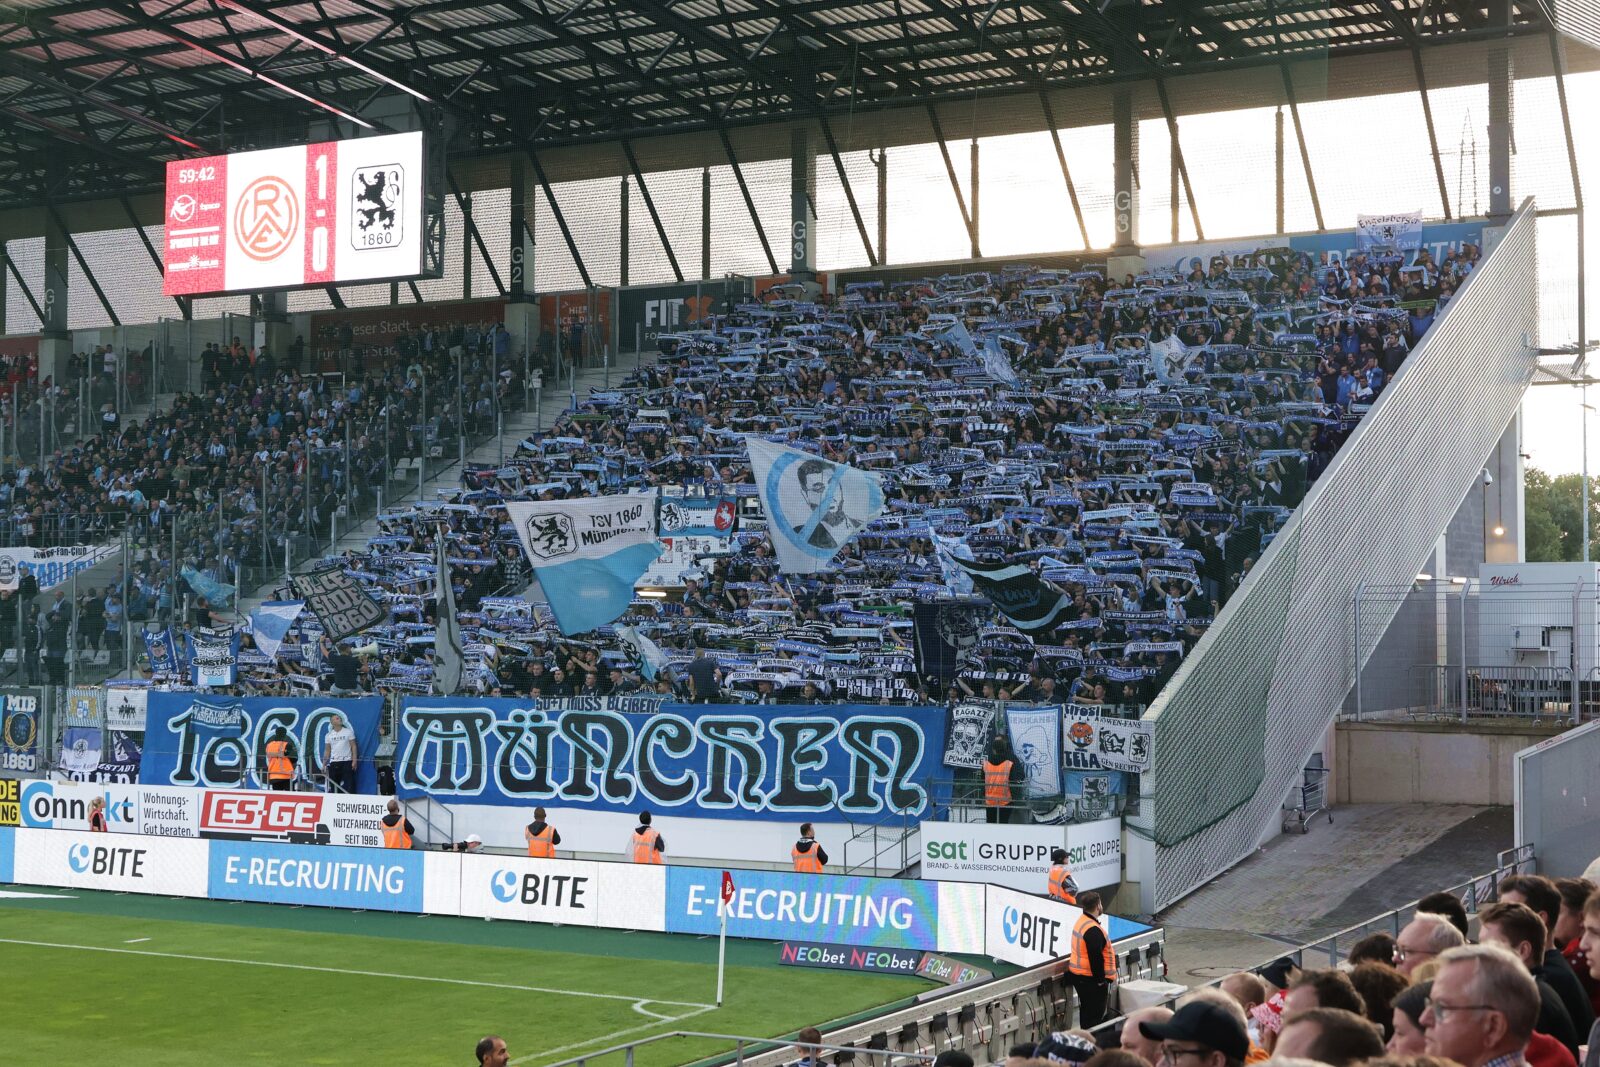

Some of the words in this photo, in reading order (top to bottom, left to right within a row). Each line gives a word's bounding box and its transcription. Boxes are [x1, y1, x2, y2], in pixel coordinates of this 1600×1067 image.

[179, 166, 214, 183] 59:42
[362, 232, 392, 246] 1860
[589, 514, 612, 528] TSV
[616, 504, 642, 526] 1860
[1489, 572, 1519, 586] Ulrich
[323, 599, 380, 638] 1860
[6, 694, 37, 712] MIB
[2, 752, 36, 771] 1860
[400, 706, 928, 814] MÜNCHEN
[1064, 751, 1101, 768] TELA
[21, 781, 134, 829] Connkt
[143, 792, 190, 808] Wohnungs-
[336, 803, 388, 815] SCHWERLAST-
[143, 808, 189, 821] Wirtschaft.
[143, 823, 157, 835] Gut
[160, 824, 194, 838] beraten.
[332, 818, 382, 831] NUTZFAHRZEU
[344, 834, 360, 844] SEIT
[361, 834, 378, 846] 1986
[926, 840, 968, 860] sat
[1070, 846, 1087, 864] sat
[1090, 839, 1120, 858] GRUPPE
[92, 846, 147, 878] BITE
[926, 862, 952, 870] BRAND-
[961, 864, 1050, 874] WASSERSCHADENSANIERU
[225, 856, 405, 895] E-RECRUITING
[521, 872, 589, 909] BITE
[686, 884, 914, 931] E-RECRUITING
[1020, 912, 1061, 958] BITE
